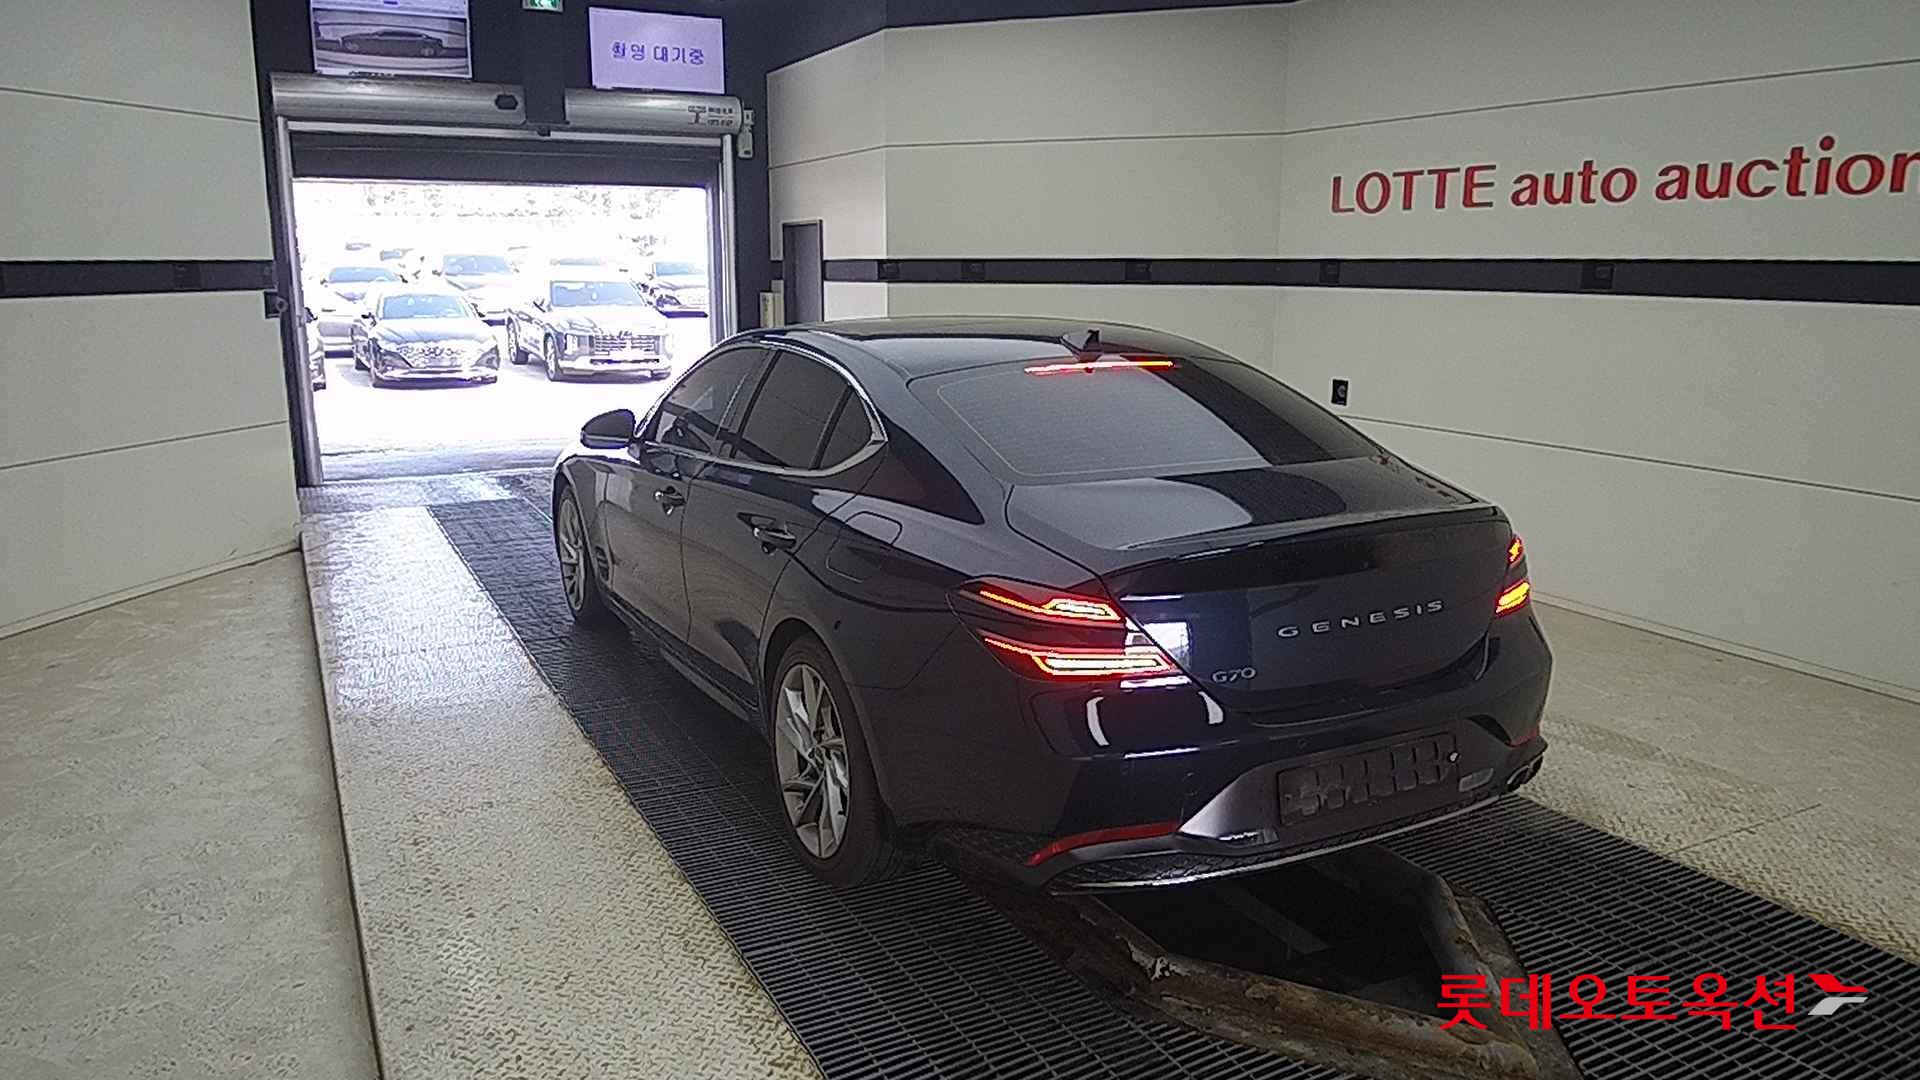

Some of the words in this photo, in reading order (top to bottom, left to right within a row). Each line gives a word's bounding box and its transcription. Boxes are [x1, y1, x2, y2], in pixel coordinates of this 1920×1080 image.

[653, 46, 704, 65] 대기중
[1332, 164, 1496, 214] LOTTE
[1511, 160, 1638, 207] auto
[1277, 600, 1443, 638] GENESIS
[1212, 666, 1256, 683] G70
